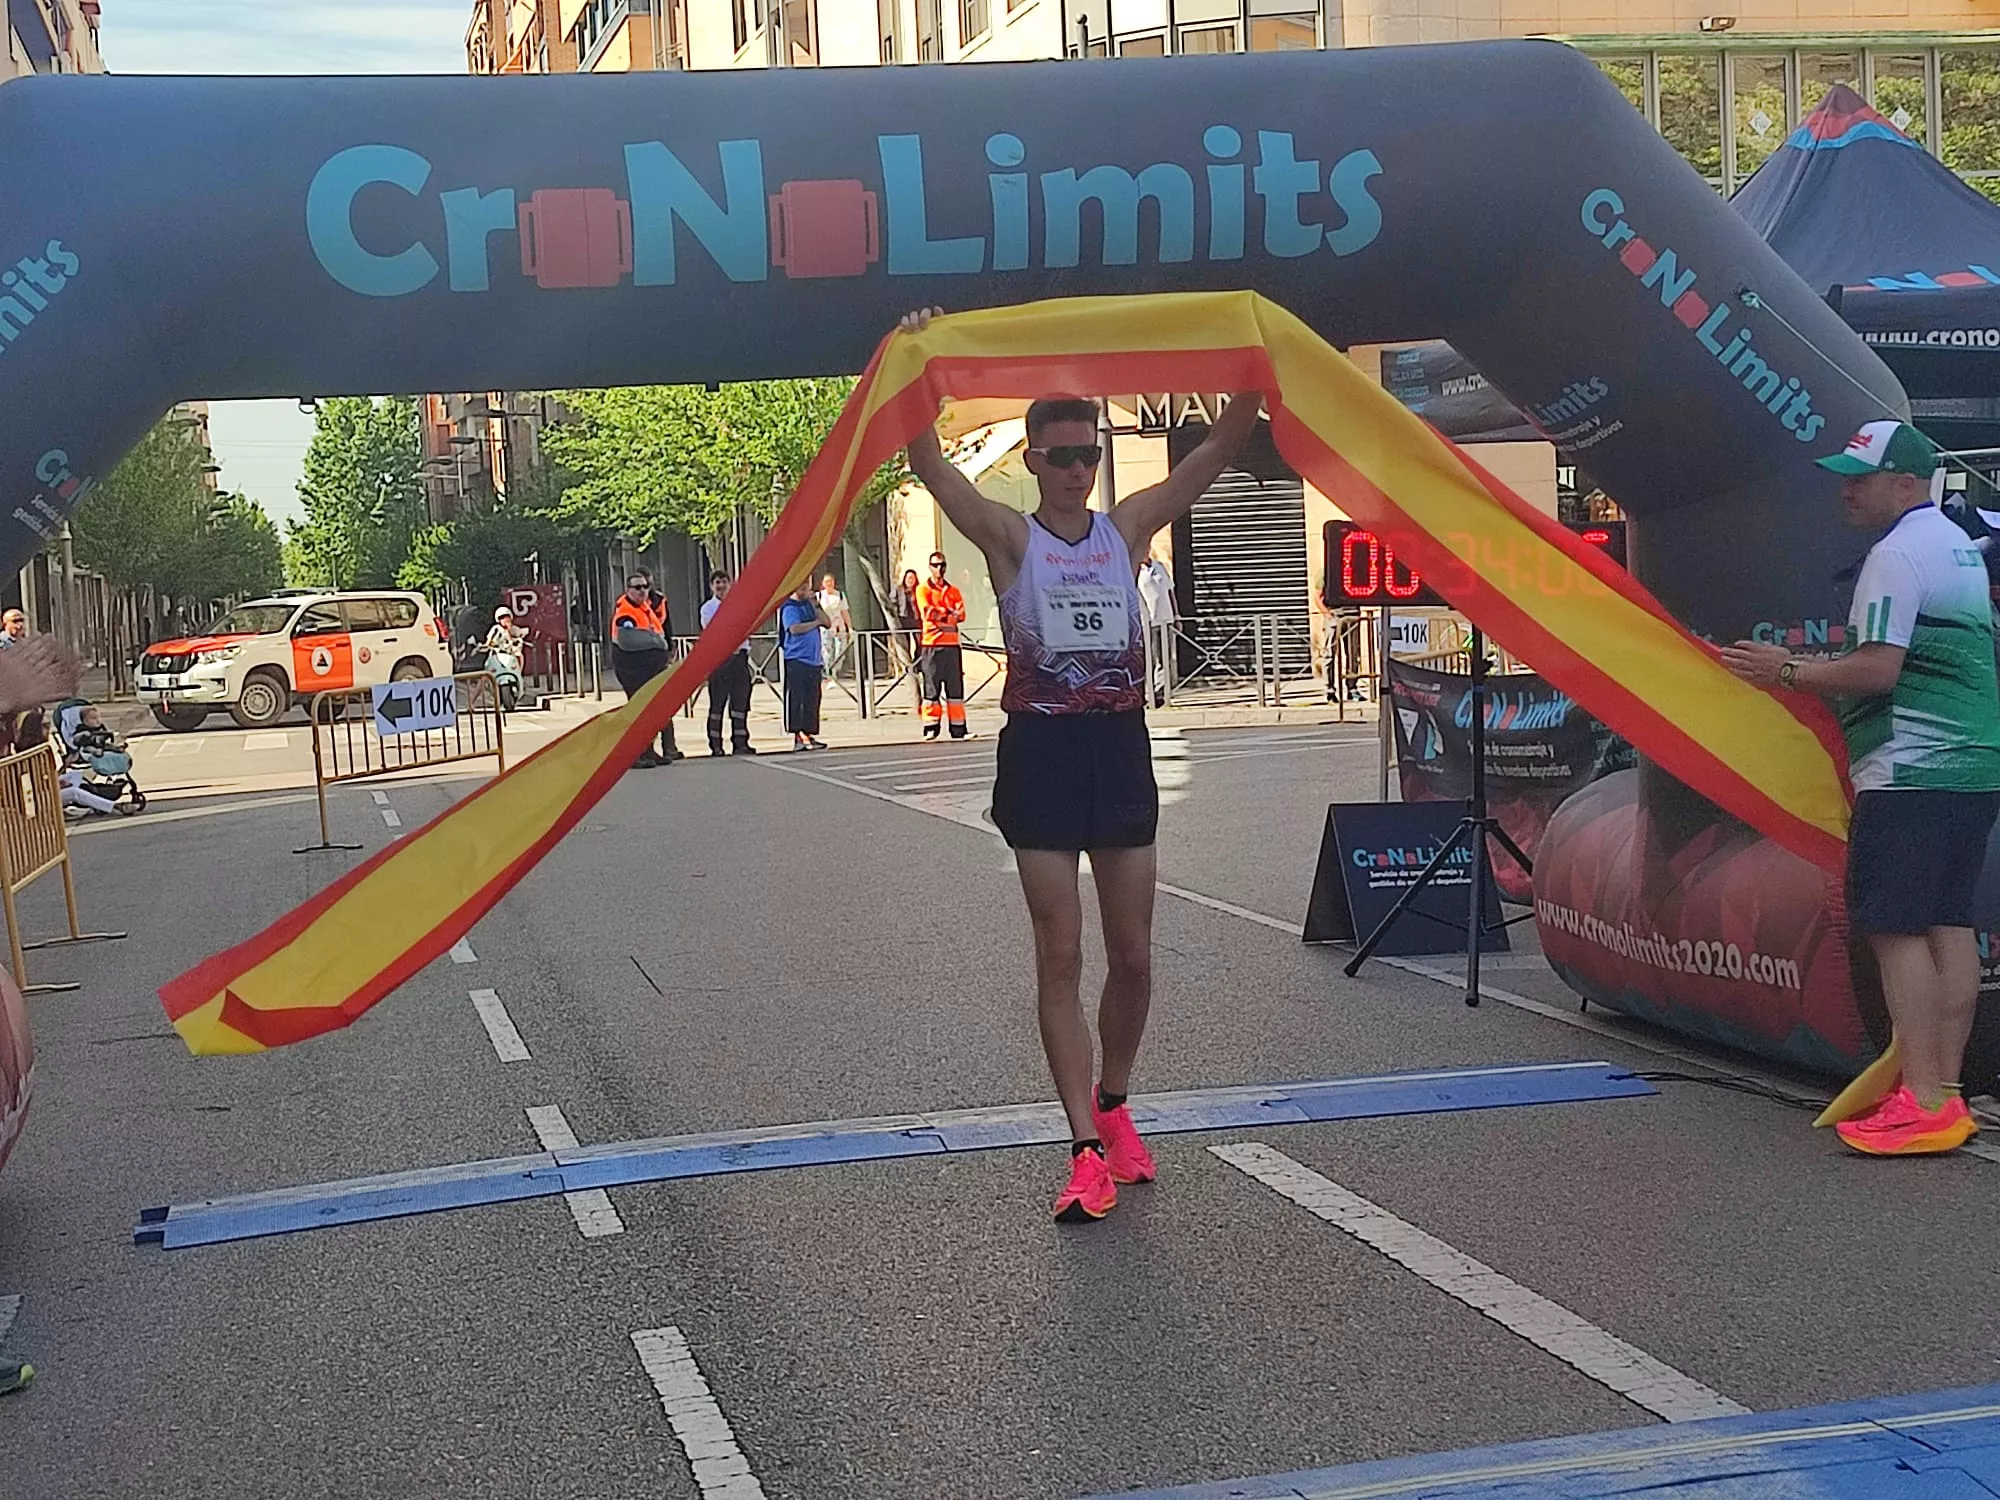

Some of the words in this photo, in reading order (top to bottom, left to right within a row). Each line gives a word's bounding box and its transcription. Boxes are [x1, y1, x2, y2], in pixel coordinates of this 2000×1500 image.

[1073, 612, 1103, 631] 86
[1403, 623, 1428, 644] 10K
[415, 685, 456, 717] 10K
[1538, 899, 1800, 989] www.cronolimits2020.com
